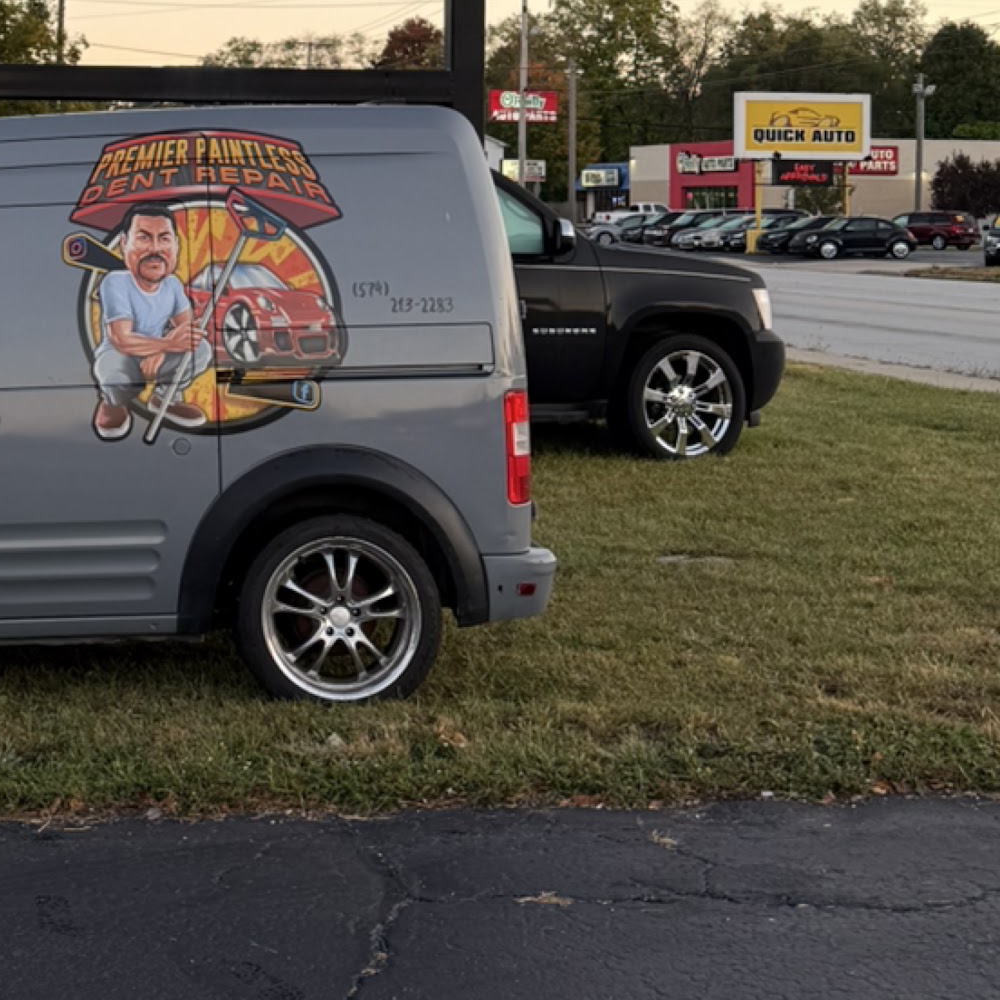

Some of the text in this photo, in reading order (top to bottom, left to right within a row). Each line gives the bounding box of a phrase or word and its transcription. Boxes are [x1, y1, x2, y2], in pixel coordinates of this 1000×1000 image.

[753, 128, 856, 143] QUICK AUTO
[91, 137, 317, 185] PREMIER PAINTLESS
[860, 160, 897, 171] PARTS
[80, 166, 331, 206] DENT REPAIR
[352, 280, 389, 298] (574)
